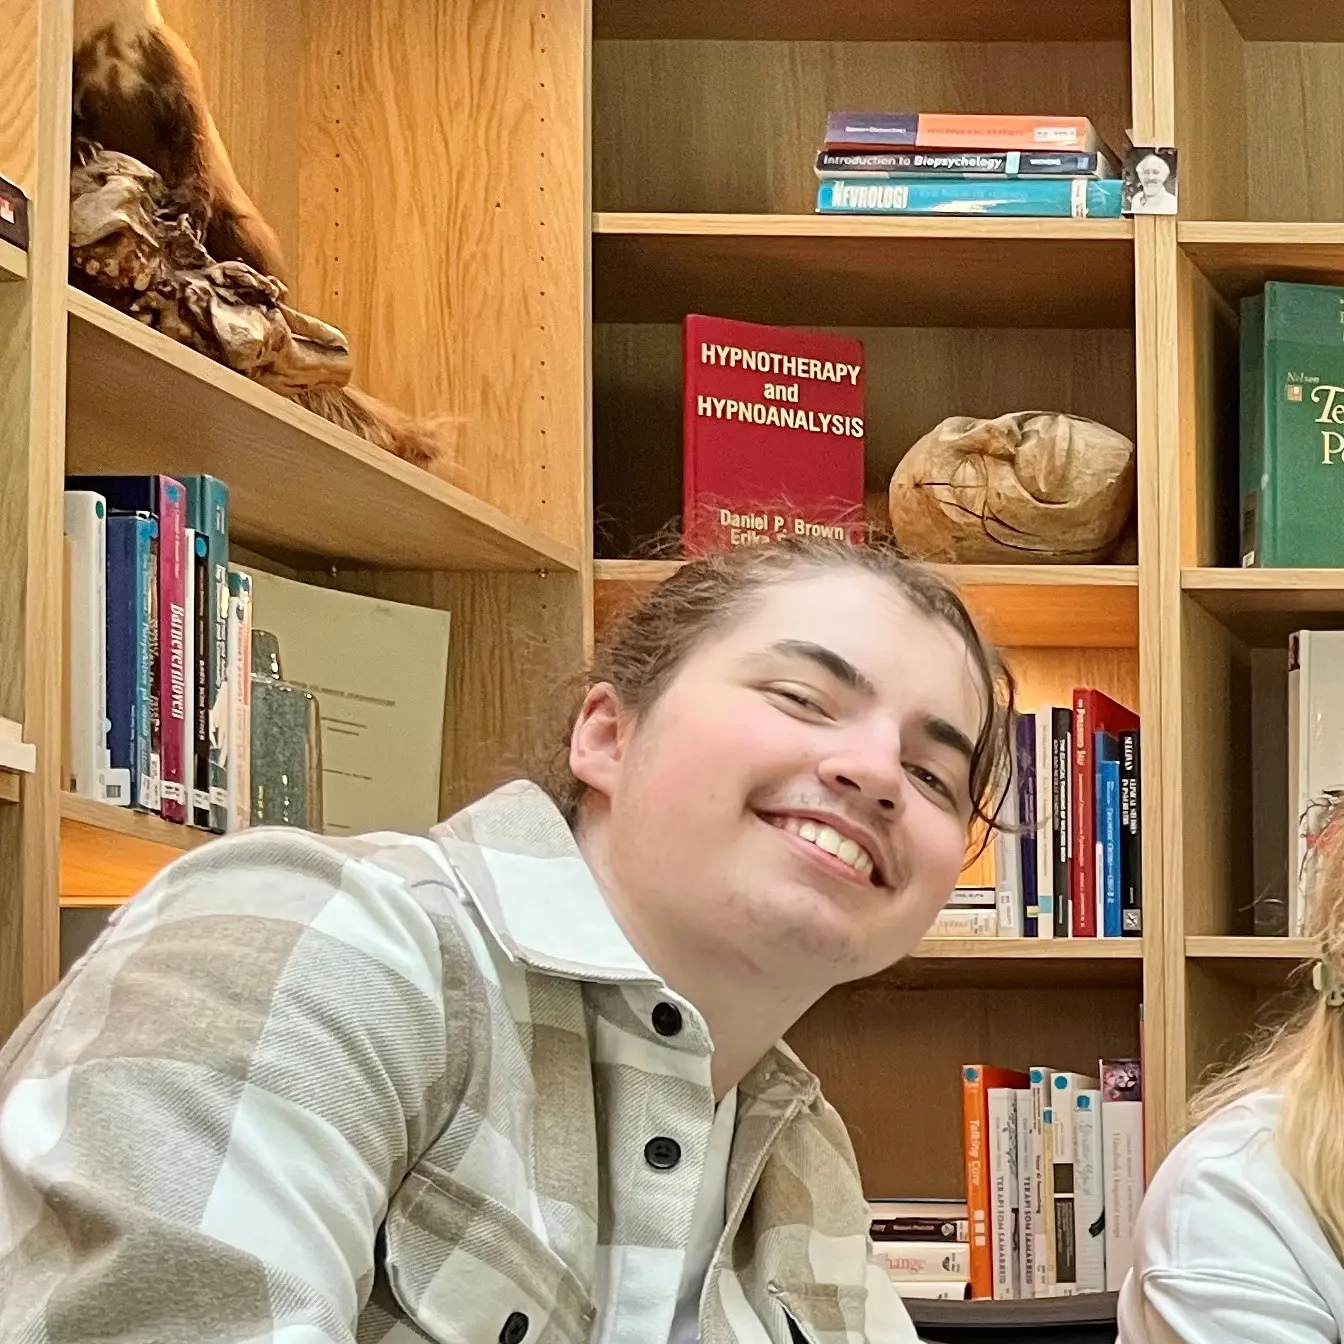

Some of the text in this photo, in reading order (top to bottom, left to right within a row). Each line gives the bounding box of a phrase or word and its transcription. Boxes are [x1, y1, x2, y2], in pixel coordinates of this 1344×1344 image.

[823, 155, 1002, 169] Introduction to Biopsychology
[701, 343, 861, 385] HYPNOTHERAPY
[1287, 371, 1320, 384] Nelson
[763, 383, 799, 403] and
[697, 395, 864, 438] HYPNOANALYSIS
[720, 509, 845, 541] Daniel P. Brown
[969, 1119, 980, 1158] Talking
[996, 1175, 1006, 1285] TERAPI SOM SAMARBEID
[1023, 1176, 1033, 1285] TERAPI SOM SAMARBEID
